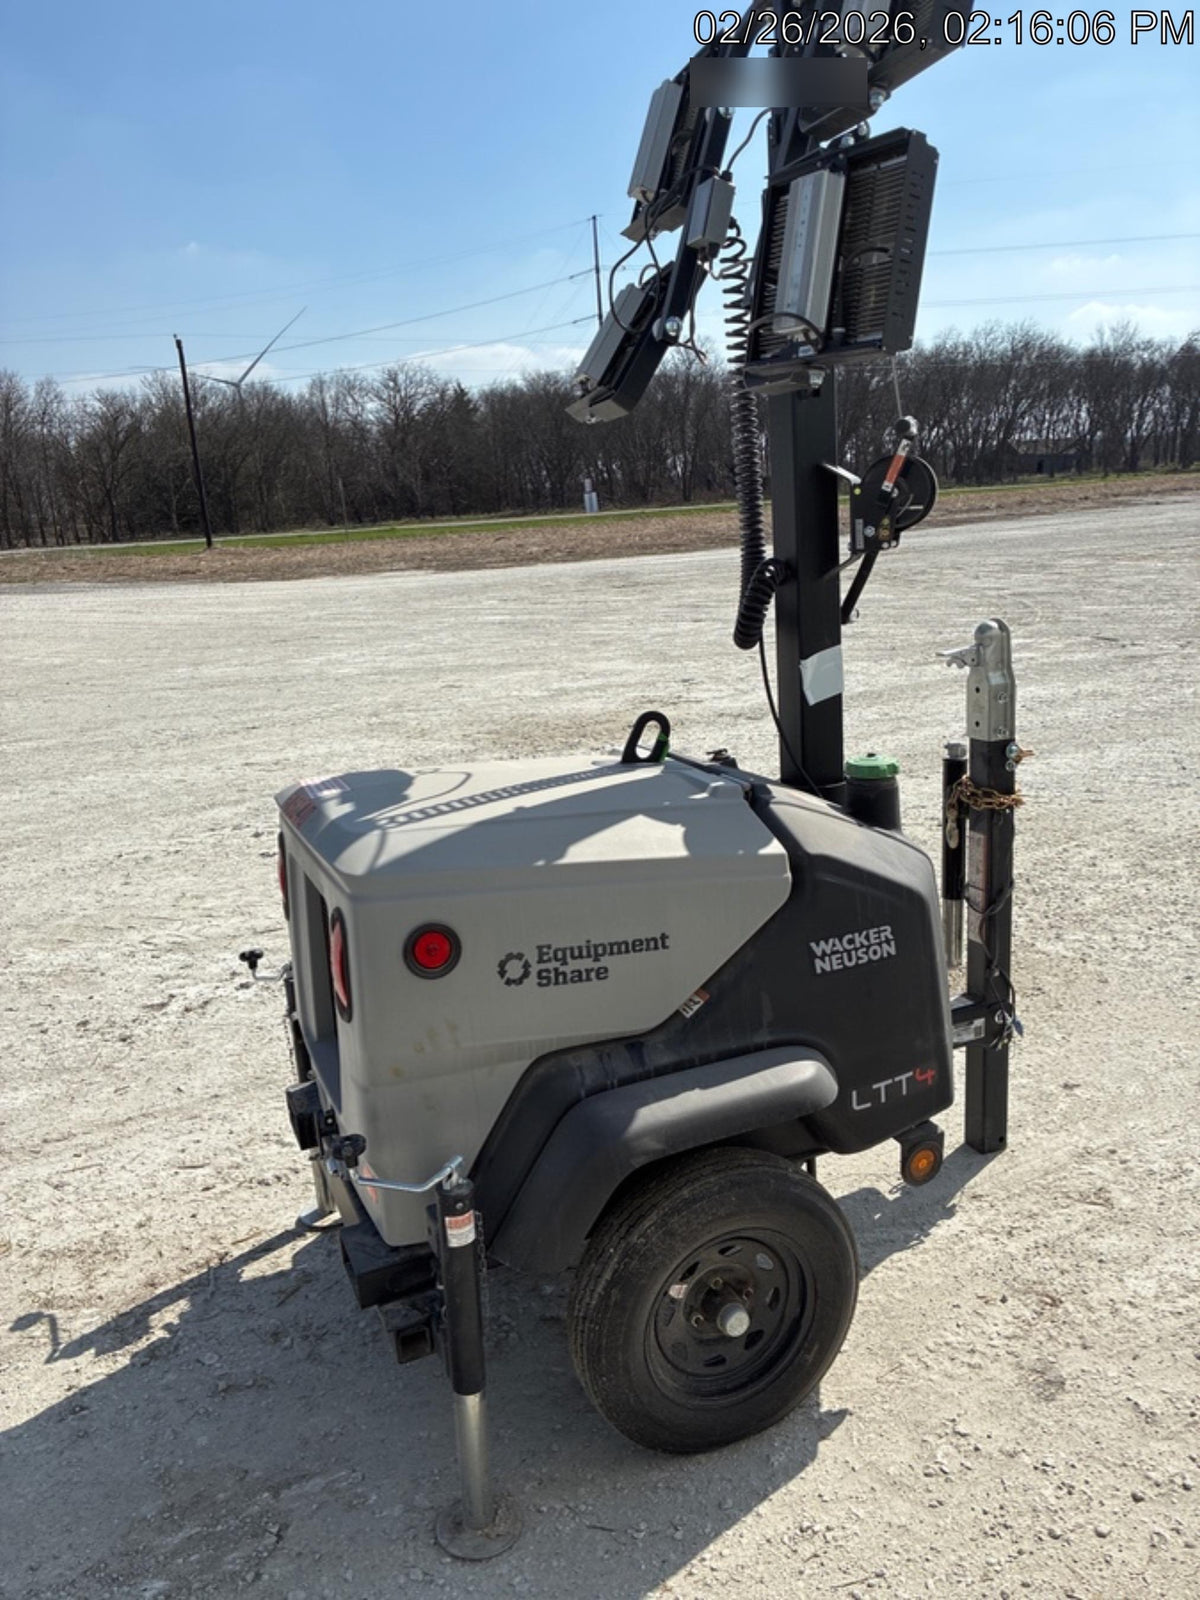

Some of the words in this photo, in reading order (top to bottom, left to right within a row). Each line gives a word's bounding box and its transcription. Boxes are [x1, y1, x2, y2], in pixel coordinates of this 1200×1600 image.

[536, 932, 670, 966] Equipment
[809, 925, 895, 957] WACKER
[814, 940, 897, 974] NEUSON
[536, 966, 609, 987] Share
[851, 1067, 936, 1110] LTT4
